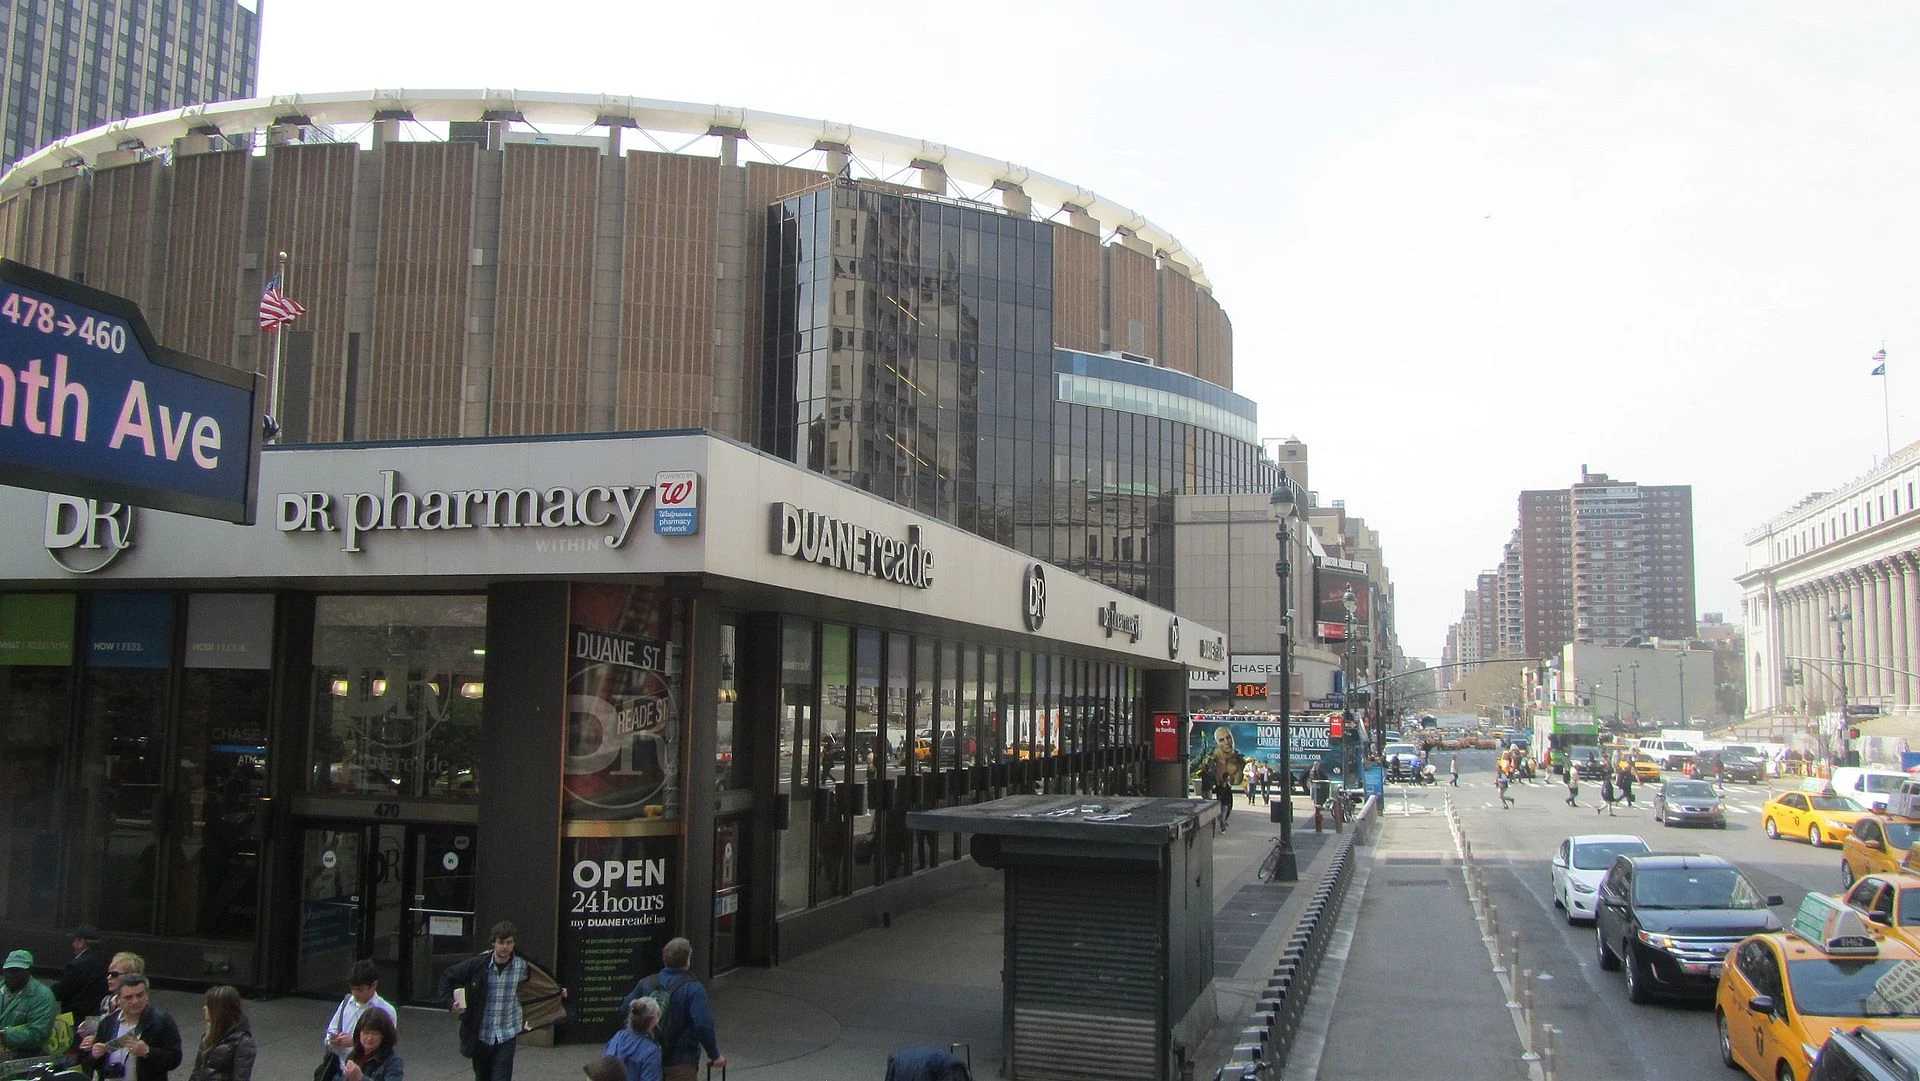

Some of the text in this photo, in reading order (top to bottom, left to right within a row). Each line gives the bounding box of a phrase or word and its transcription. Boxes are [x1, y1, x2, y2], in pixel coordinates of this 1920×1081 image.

[1, 293, 126, 354] 478 460
[109, 380, 222, 470] Ave
[276, 470, 654, 553] DR pharmacy
[659, 511, 692, 519] Walgreens
[45, 493, 131, 549] DR
[536, 539, 599, 553] WITHIN
[1028, 577, 1046, 618] DR
[94, 642, 115, 651] HOW
[193, 643, 215, 651] HOW
[577, 631, 660, 670] DUANE ST
[1231, 664, 1273, 673] CHASE
[617, 702, 653, 735] READE
[1257, 726, 1280, 738] NOW
[1289, 738, 1300, 747] HE
[1301, 739, 1313, 747] BIG
[374, 803, 400, 818] 470
[572, 858, 665, 889] OPEN
[570, 918, 585, 930] my
[654, 914, 666, 924] has
